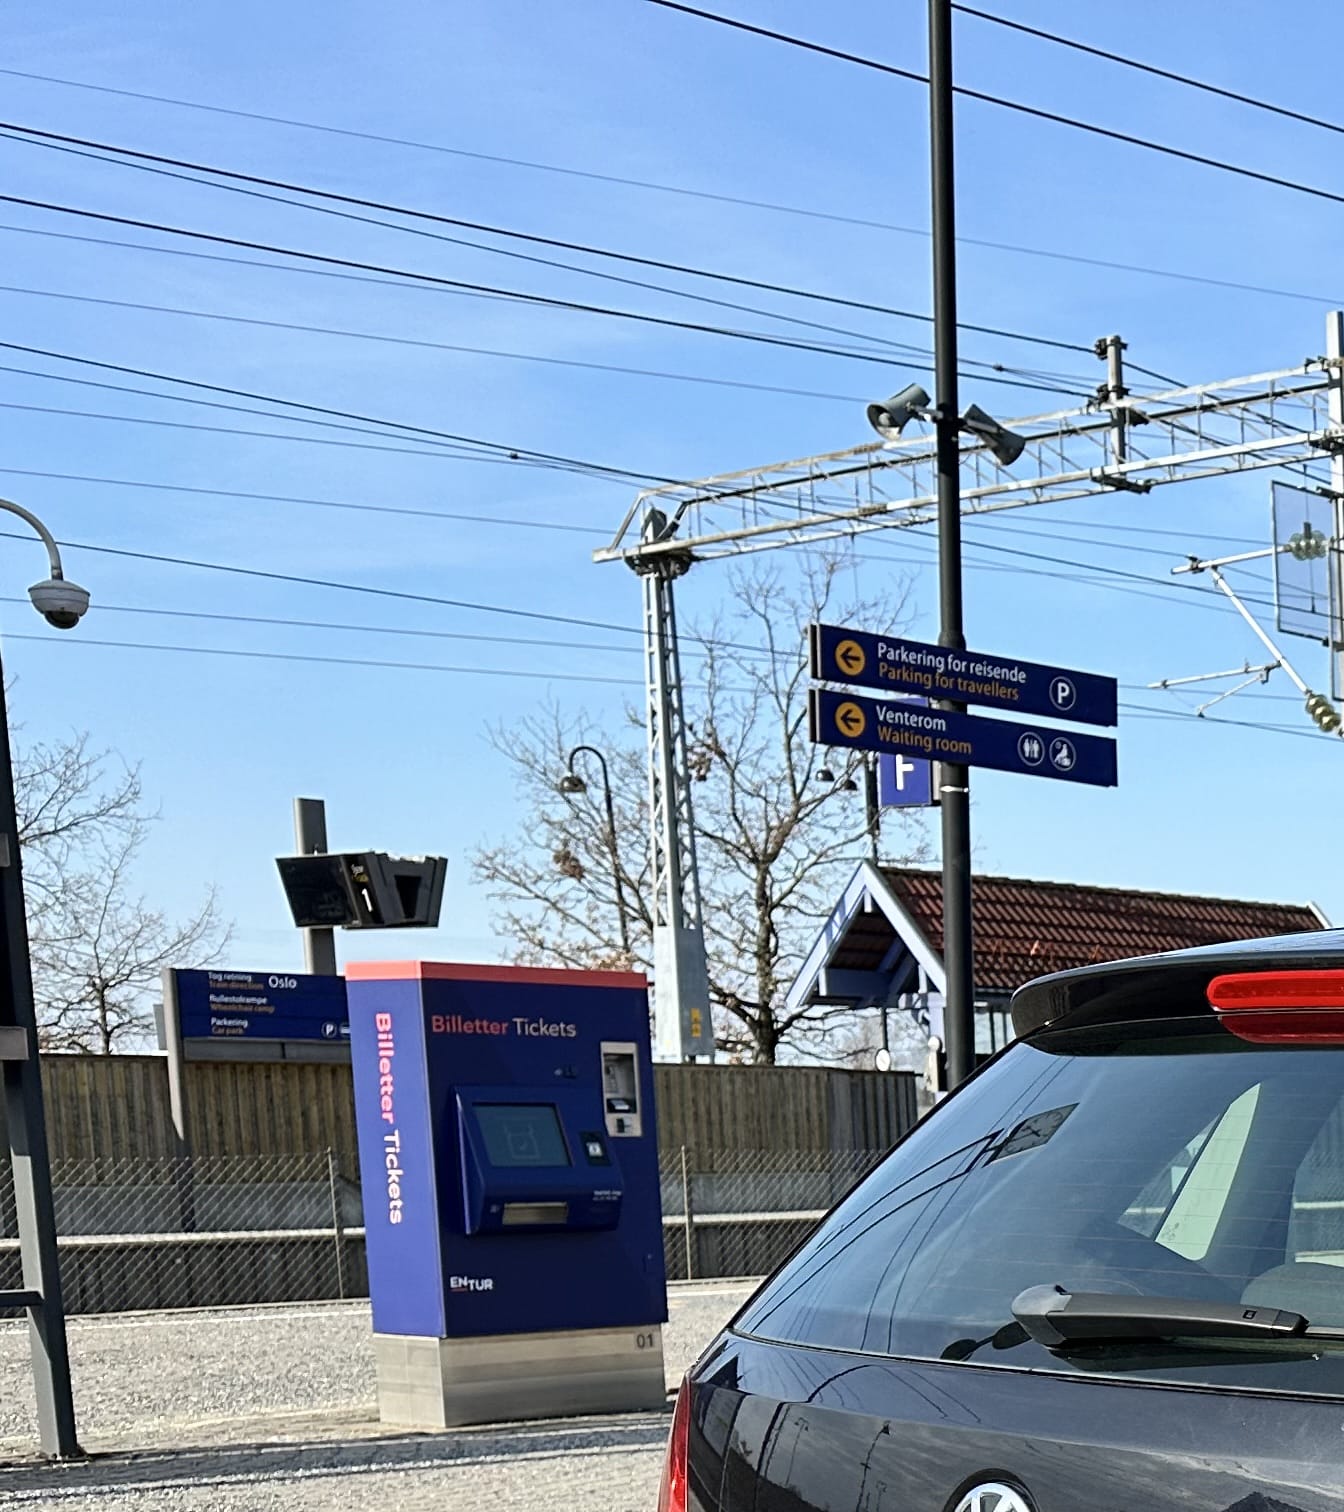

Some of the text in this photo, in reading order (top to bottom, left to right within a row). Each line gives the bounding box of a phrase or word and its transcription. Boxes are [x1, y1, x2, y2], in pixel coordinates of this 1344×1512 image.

[877, 642, 1027, 684] Parkering for reisende
[878, 662, 1020, 701] Parking for travellers
[876, 705, 946, 732] Venterom
[877, 724, 972, 755] Waiting room
[361, 888, 373, 912] 1
[268, 974, 298, 989] Oslo
[210, 1017, 249, 1029] Parkering
[430, 1015, 577, 1038] Billetter Tickets
[374, 1012, 403, 1226] Billetter Tickets
[636, 1333, 655, 1350] 01
